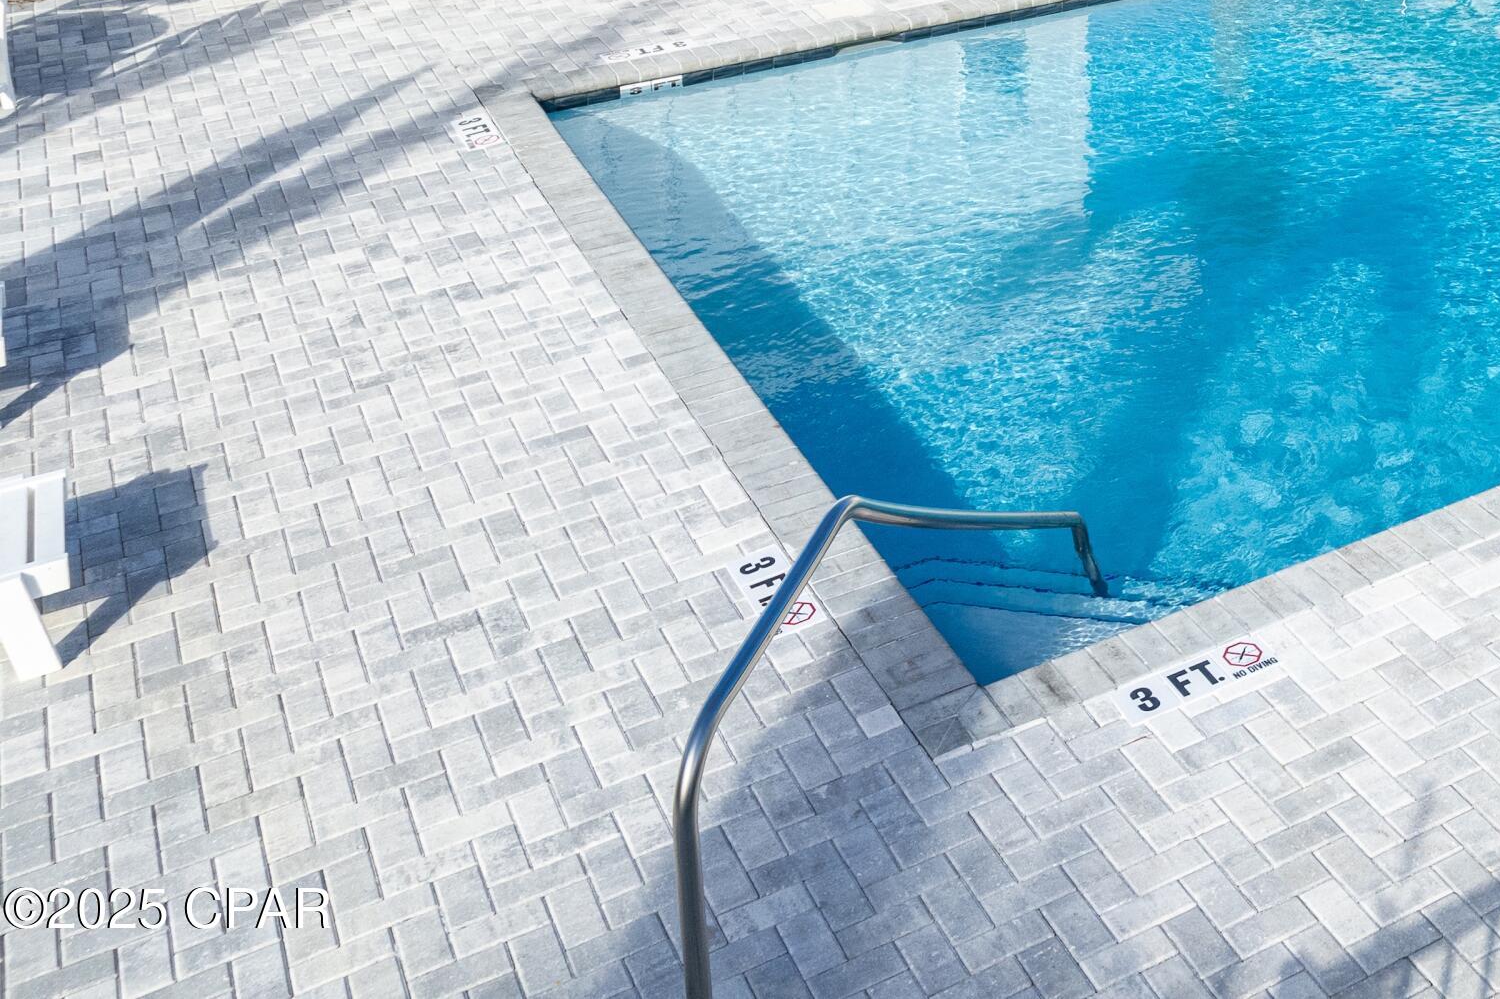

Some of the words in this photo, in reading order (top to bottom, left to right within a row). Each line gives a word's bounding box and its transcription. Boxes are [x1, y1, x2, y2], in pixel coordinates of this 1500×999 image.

[458, 117, 482, 126] 3
[739, 555, 776, 575] 3
[1232, 669, 1248, 680] NO
[1247, 656, 1279, 674] DIVING
[1129, 687, 1161, 712] 3
[1166, 659, 1226, 697] FT.
